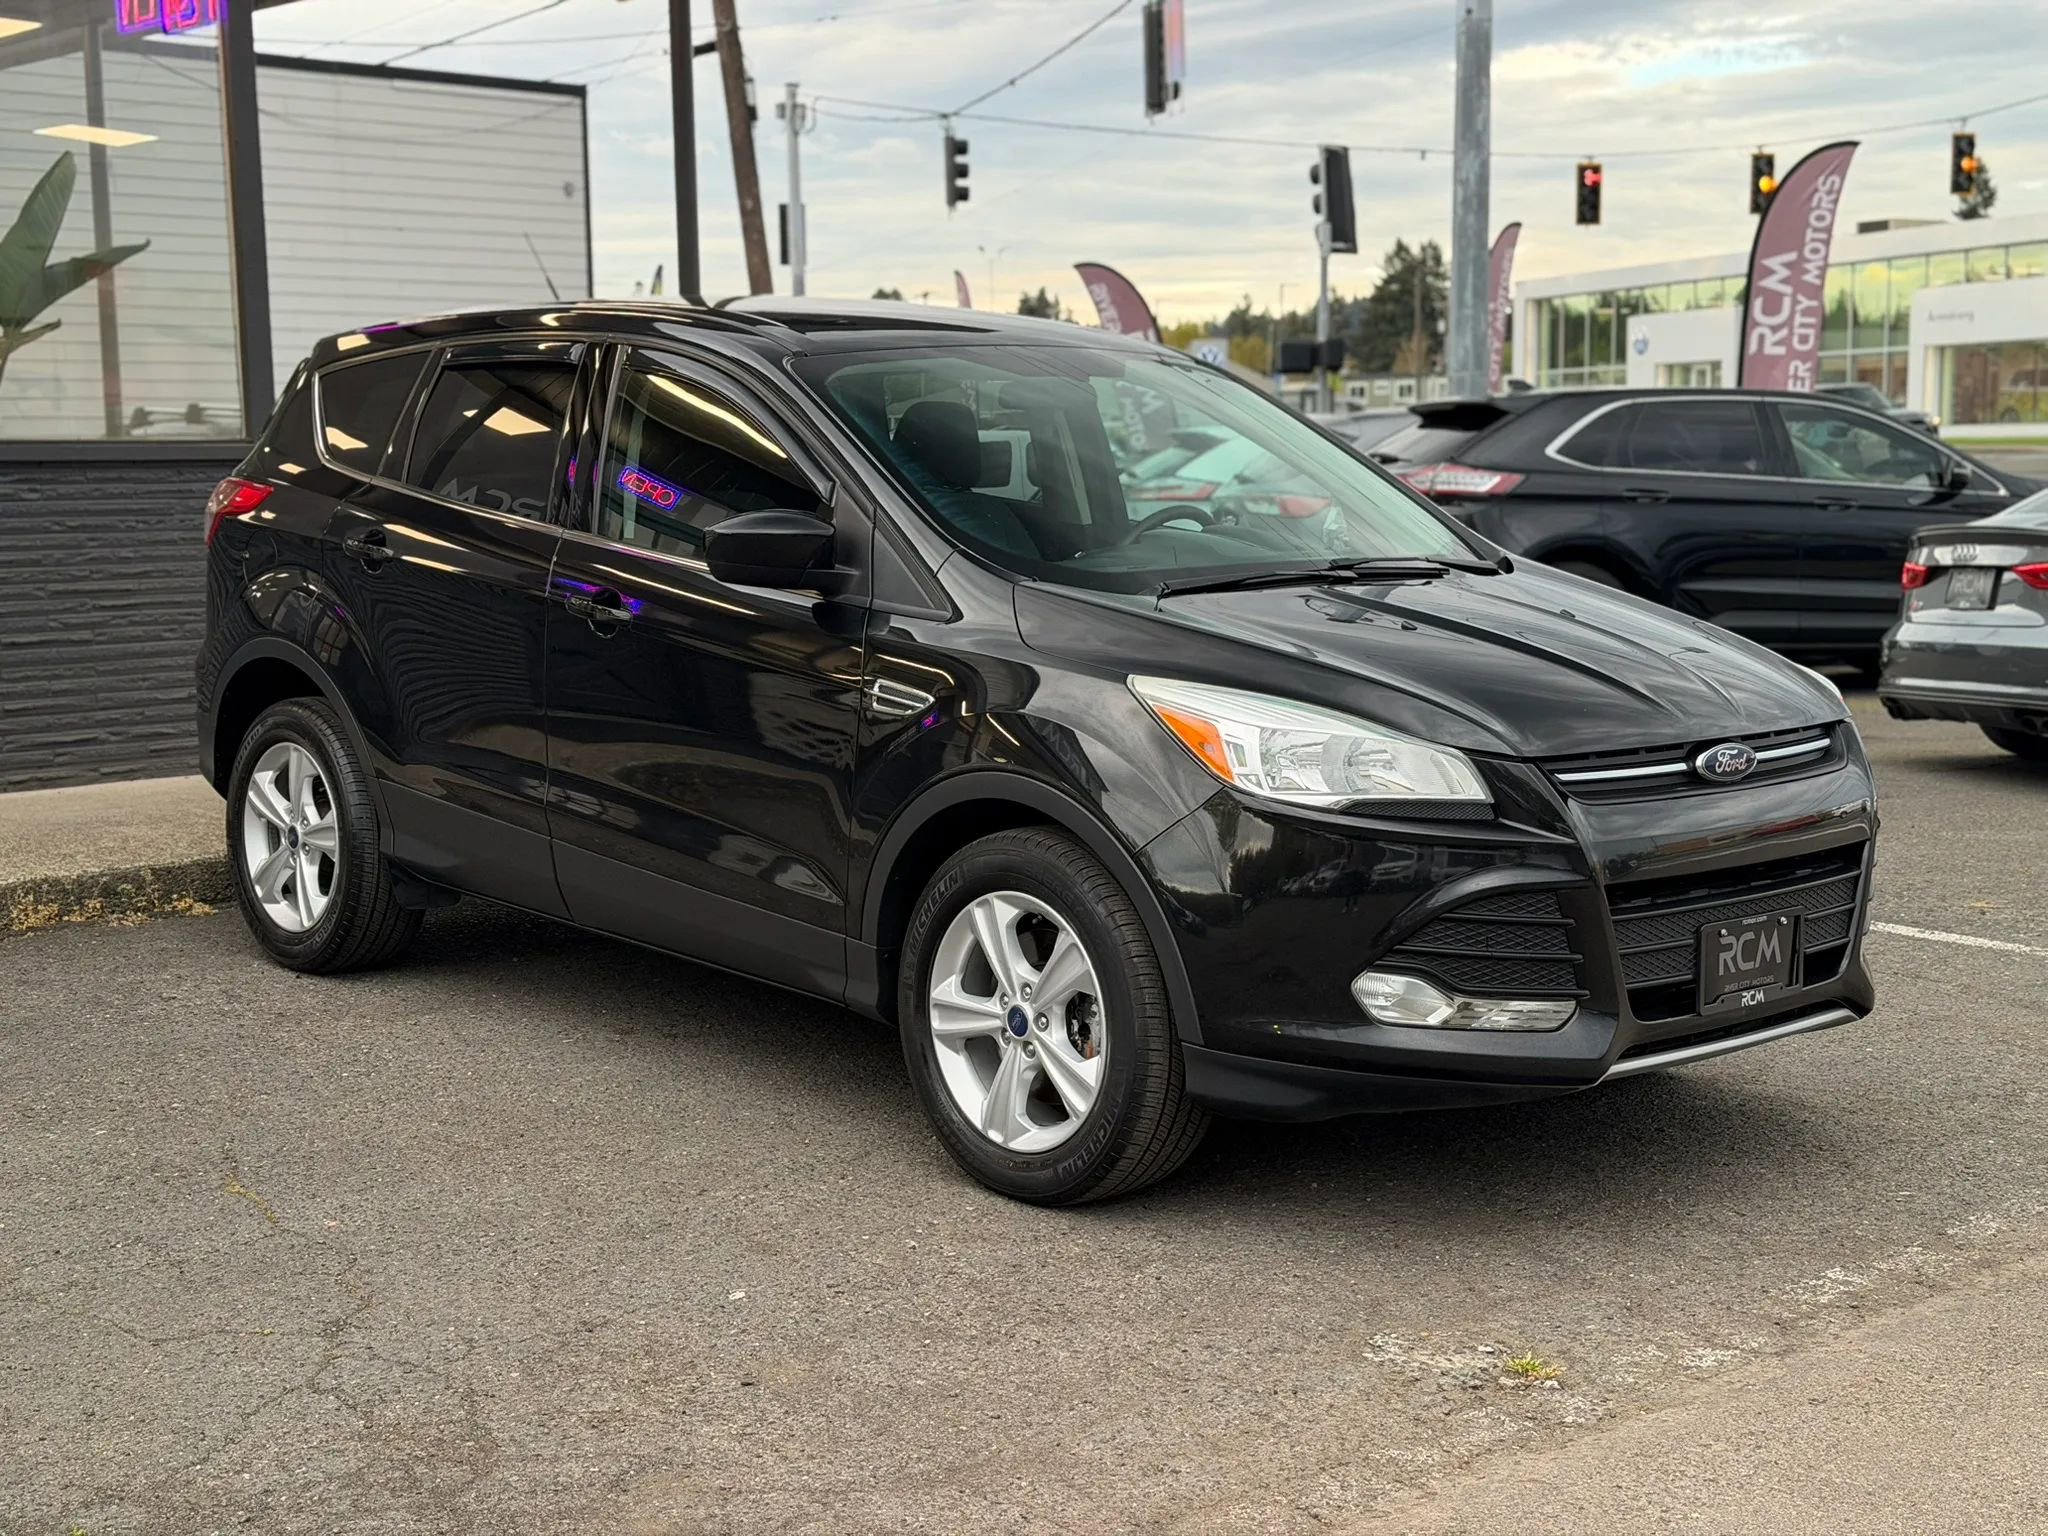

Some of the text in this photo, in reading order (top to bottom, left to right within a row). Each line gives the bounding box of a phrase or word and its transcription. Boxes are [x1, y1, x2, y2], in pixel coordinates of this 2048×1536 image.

[1800, 173, 1841, 287] MOTORS
[1748, 250, 1799, 356] RCM
[1792, 293, 1820, 352] CITY
[1715, 749, 1748, 774] Ford
[909, 867, 962, 952] MICHELIN
[1718, 927, 1782, 976] RCM
[1741, 989, 1765, 1007] RCM
